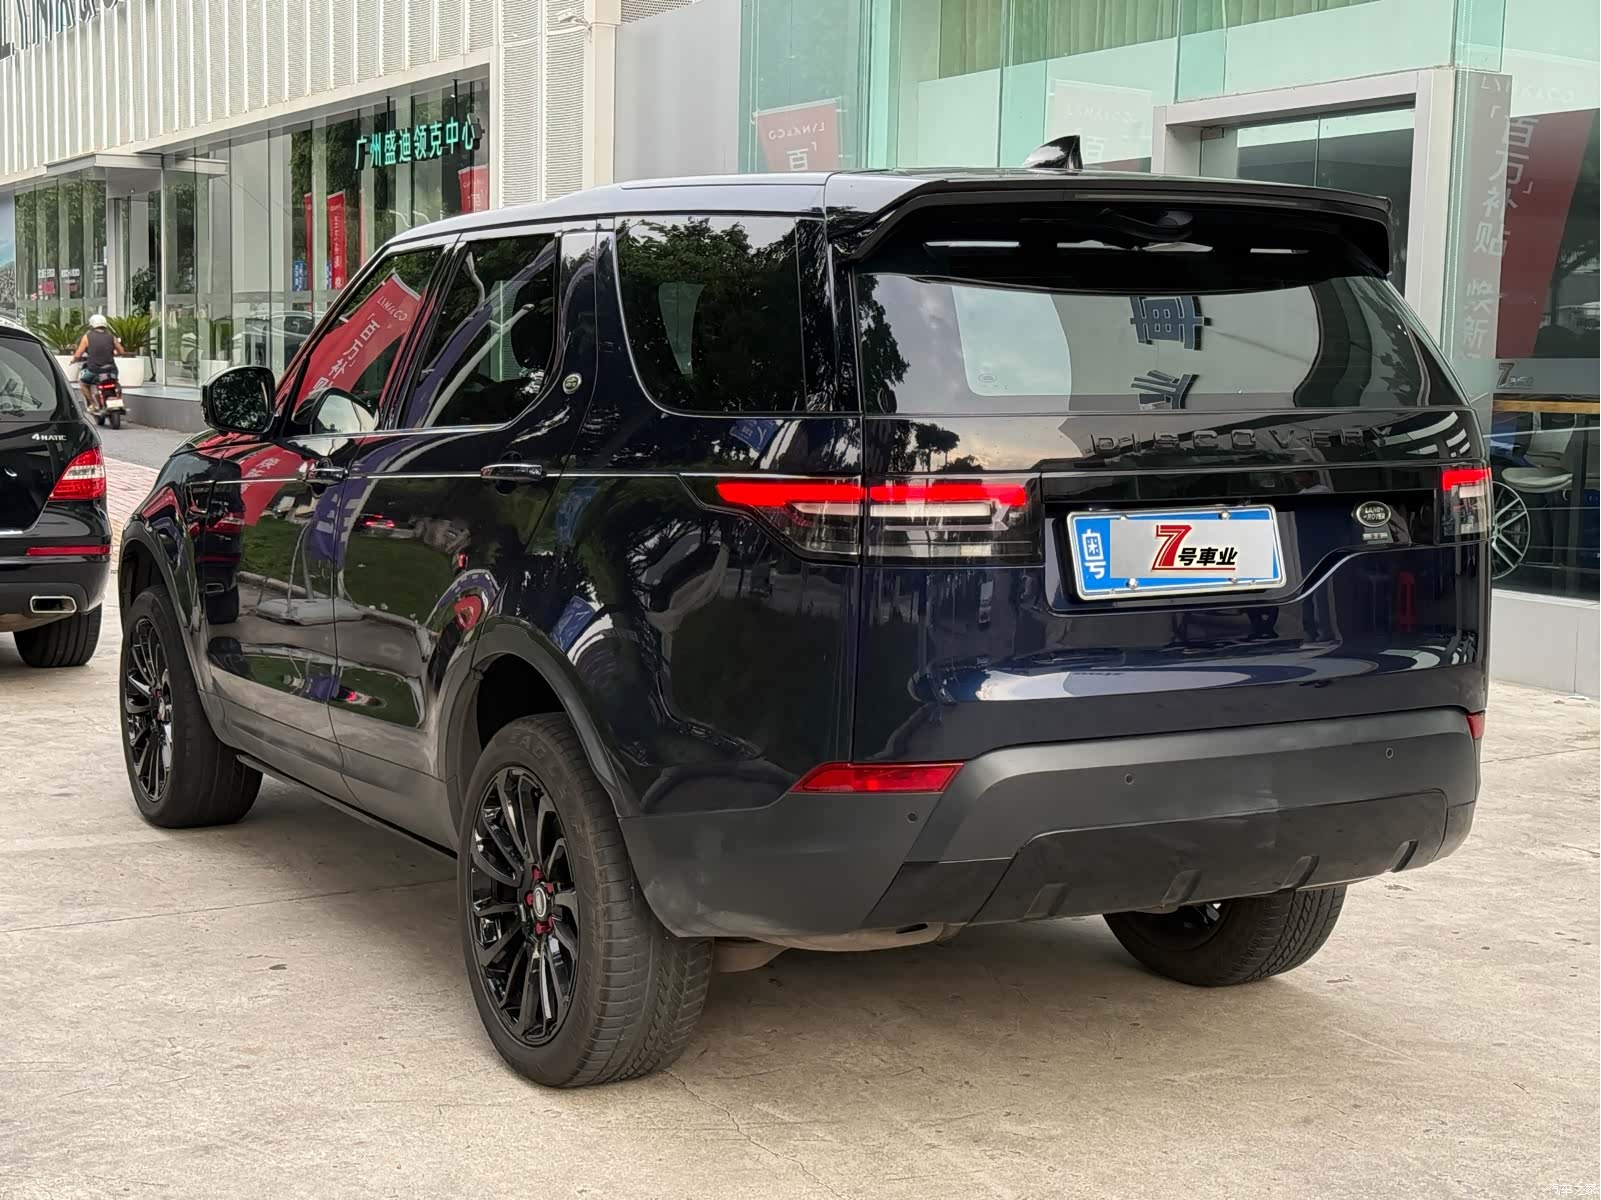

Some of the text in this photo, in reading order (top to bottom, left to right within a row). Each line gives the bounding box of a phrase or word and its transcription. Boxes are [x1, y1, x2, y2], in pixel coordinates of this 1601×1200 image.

[354, 113, 476, 170] 广州盛迪领克中心
[31, 433, 67, 441] 4MATIC
[1090, 426, 1393, 454] DISCOVERY
[1081, 528, 1107, 580] 粤
